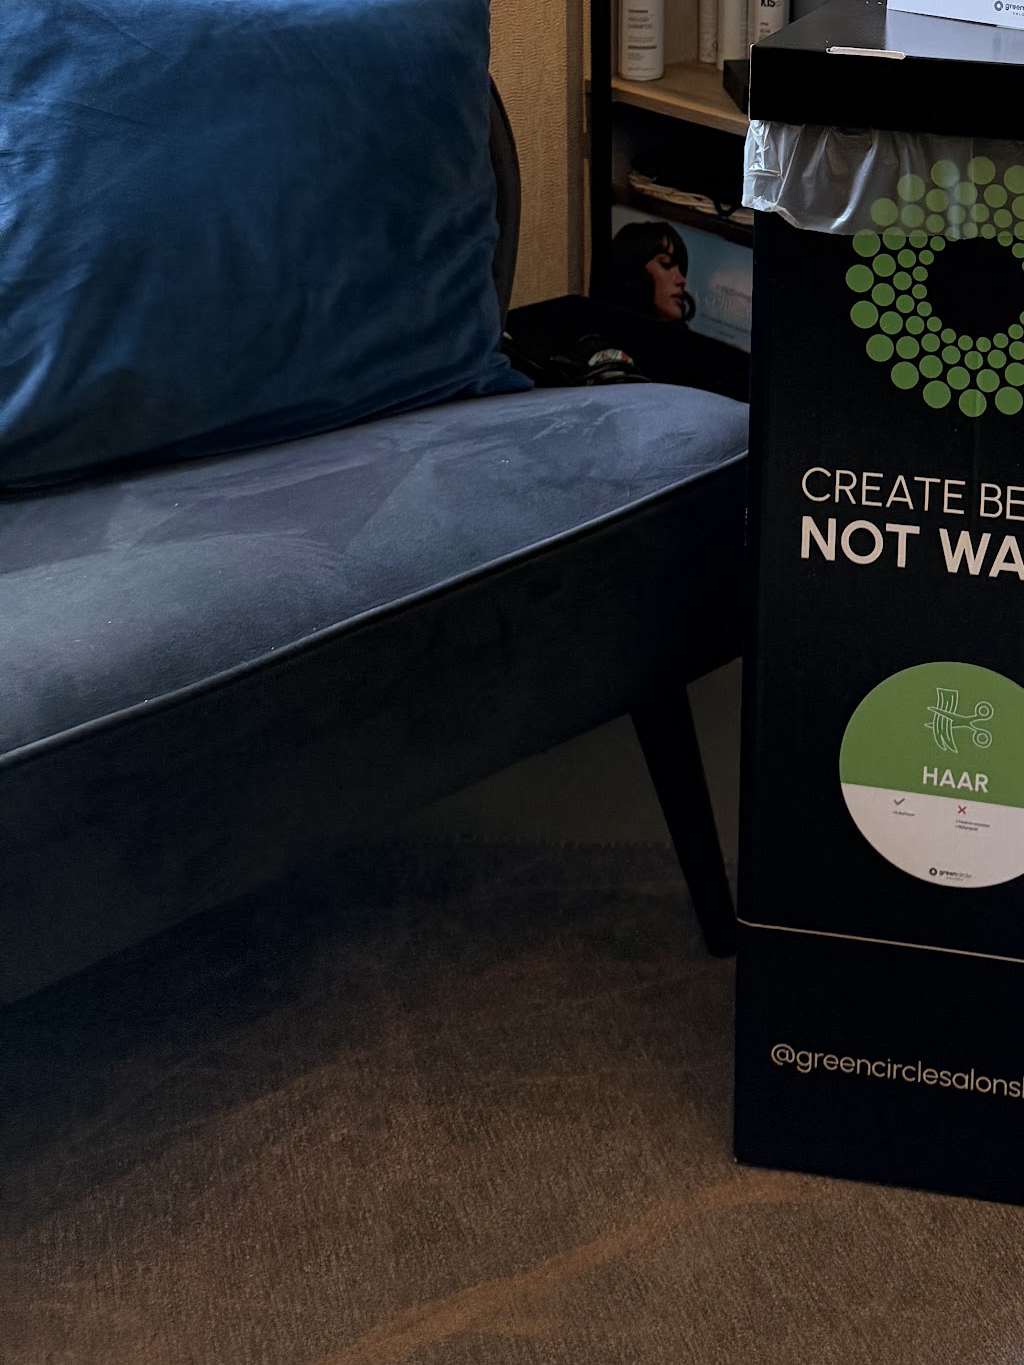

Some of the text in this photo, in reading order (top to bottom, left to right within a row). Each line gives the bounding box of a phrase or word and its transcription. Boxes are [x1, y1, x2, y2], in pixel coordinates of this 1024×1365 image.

[802, 466, 966, 515] CREATE
[800, 515, 920, 568] NOT
[922, 766, 989, 794] HAAR
